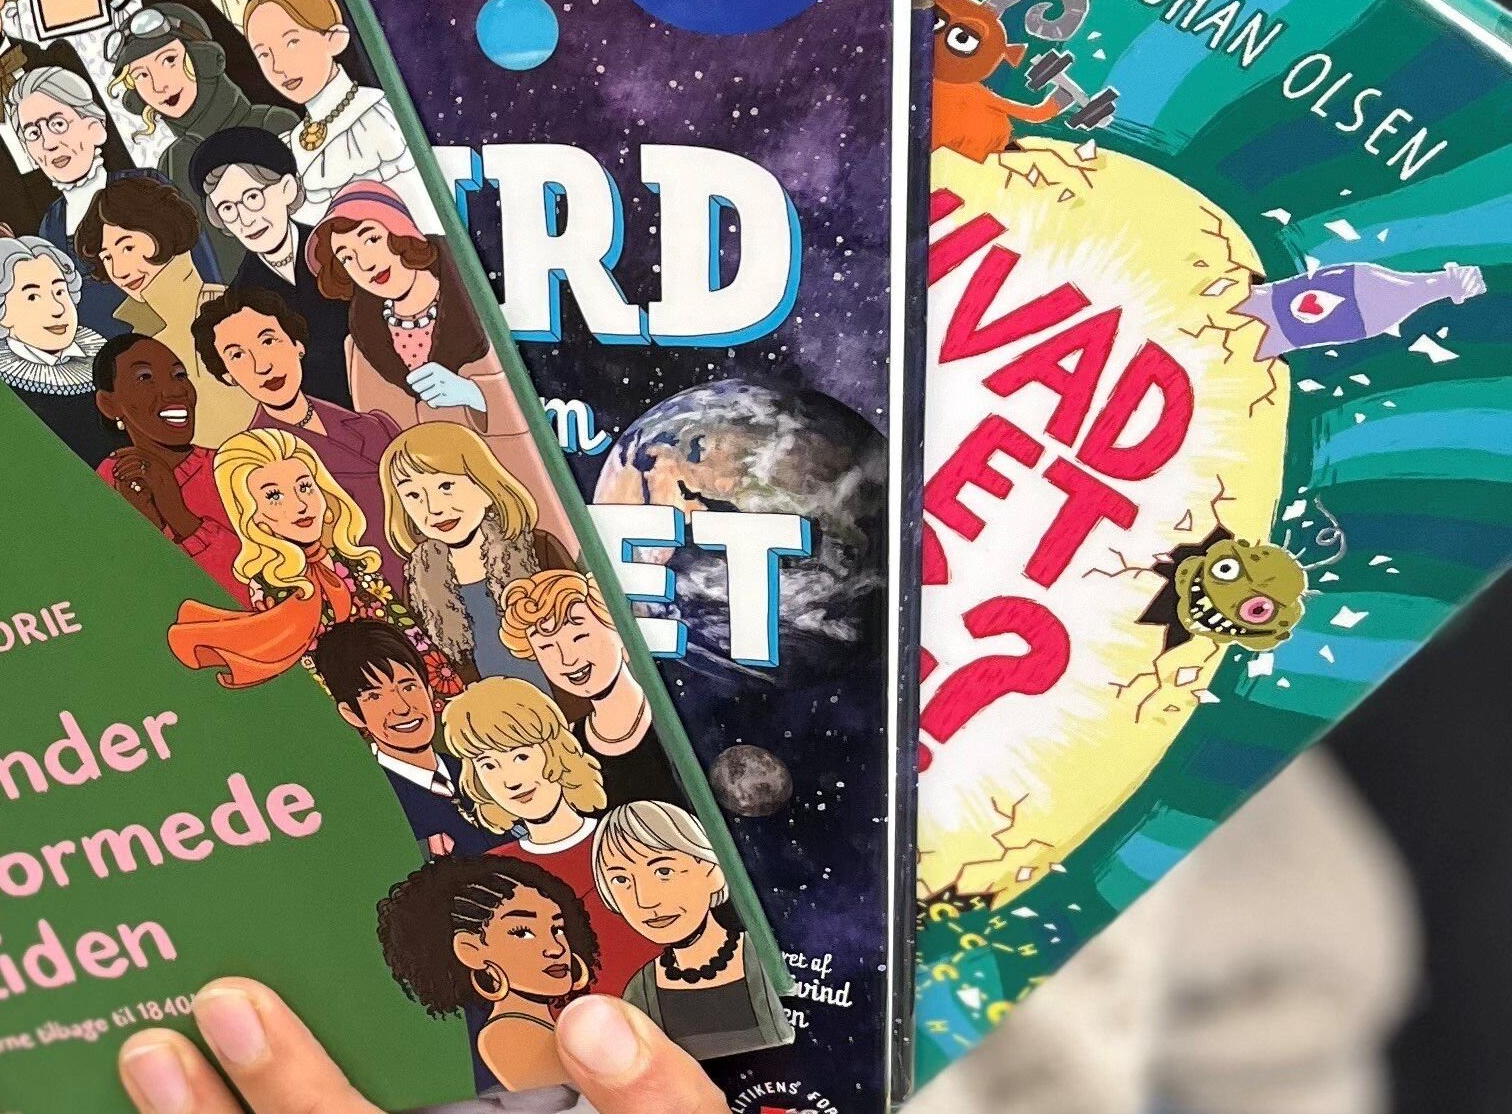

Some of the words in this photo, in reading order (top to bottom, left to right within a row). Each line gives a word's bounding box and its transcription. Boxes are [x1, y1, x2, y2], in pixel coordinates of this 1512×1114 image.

[1282, 52, 1449, 182] OLSEN
[433, 143, 802, 348] RD
[586, 503, 812, 667] ET
[792, 974, 853, 1008] vind
[810, 953, 833, 979] af
[35, 1017, 110, 1042] tilbage
[111, 1005, 137, 1028] til
